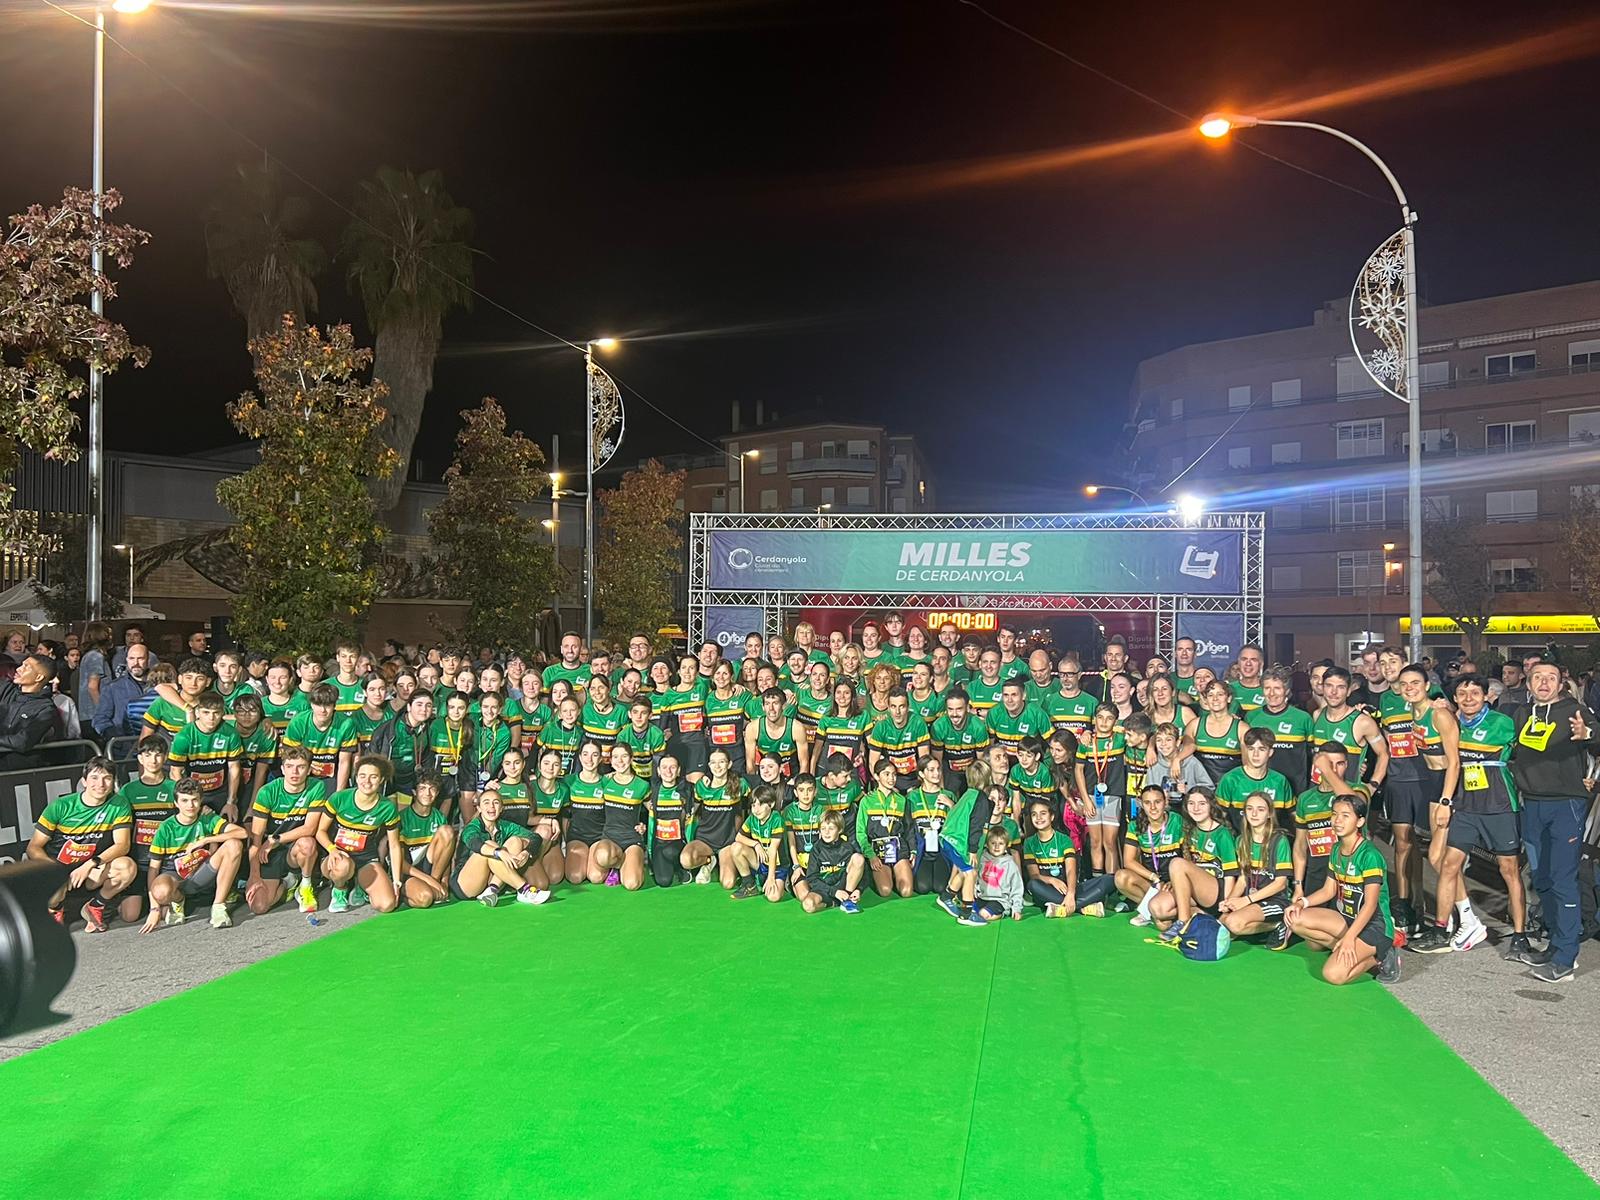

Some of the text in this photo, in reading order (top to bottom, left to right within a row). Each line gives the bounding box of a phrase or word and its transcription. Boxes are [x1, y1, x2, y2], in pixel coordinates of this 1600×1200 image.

[755, 555, 807, 565] Cerdanyola
[899, 542, 1032, 567] MILLES
[896, 570, 1025, 581] DE CERDANYOLA
